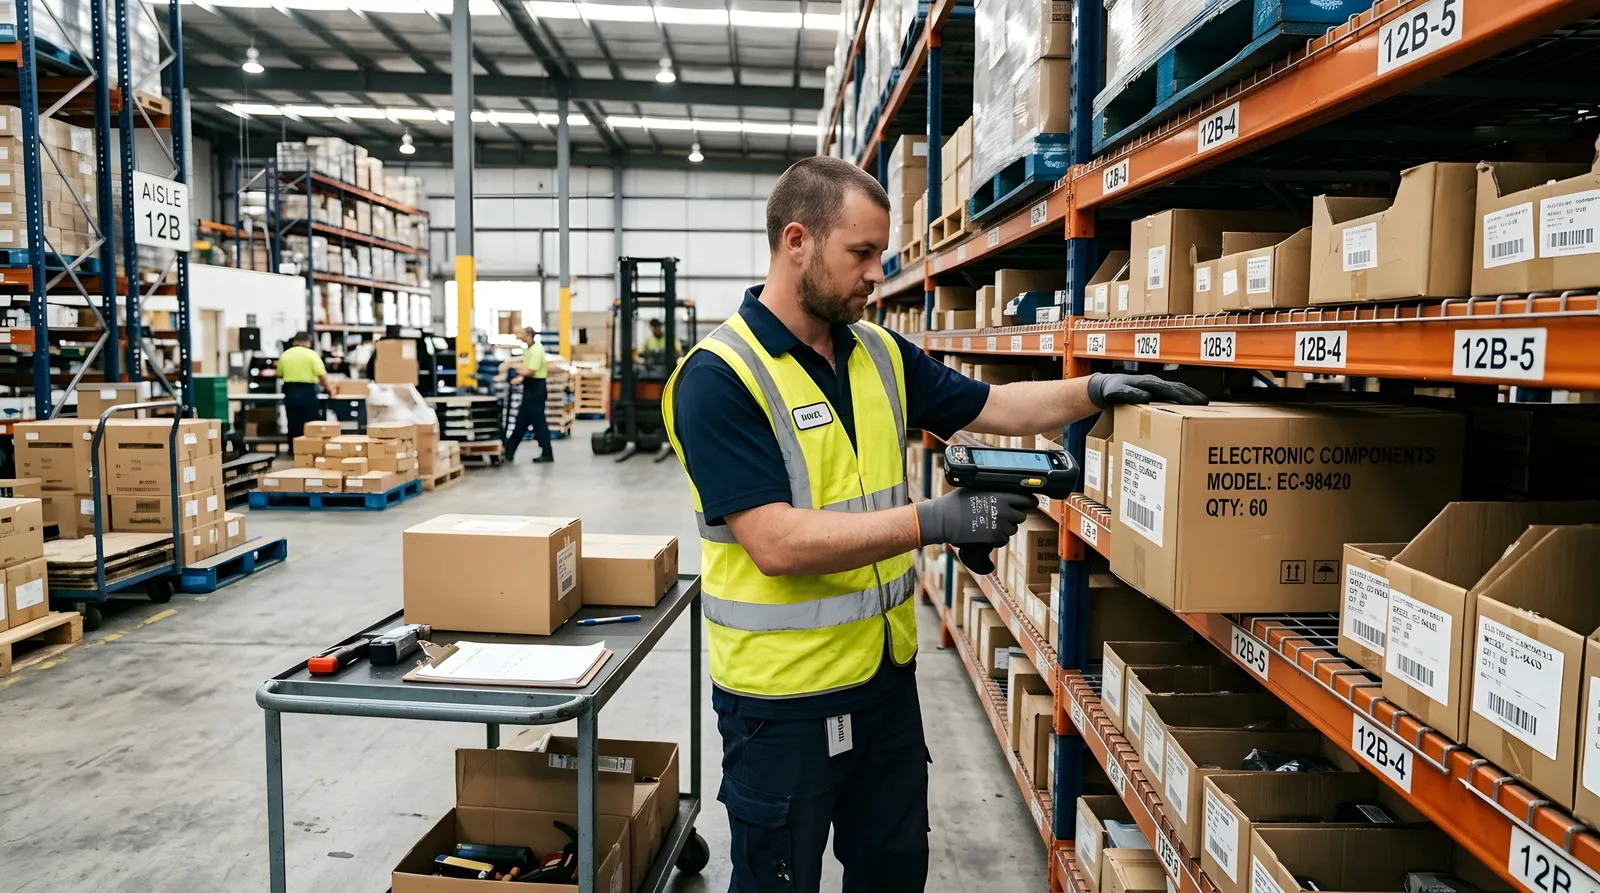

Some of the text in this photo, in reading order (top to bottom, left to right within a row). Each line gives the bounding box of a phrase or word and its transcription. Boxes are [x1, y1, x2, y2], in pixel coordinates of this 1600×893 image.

[1384, 0, 1456, 63] 12B-5
[1200, 108, 1235, 146] 12B-4
[142, 182, 181, 207] AISLE
[145, 210, 181, 240] 12B
[1204, 336, 1232, 357] 12B-3
[1299, 335, 1341, 362] 12B-4
[1462, 337, 1534, 371] 12B-5
[1208, 446, 1435, 464] ELECTRONIC COMPONENTS
[1207, 472, 1350, 490] MODEL: EC-98420
[1205, 498, 1267, 517] QTY: 60
[1234, 633, 1265, 673] 12B-5
[1358, 725, 1406, 780] 12B-4
